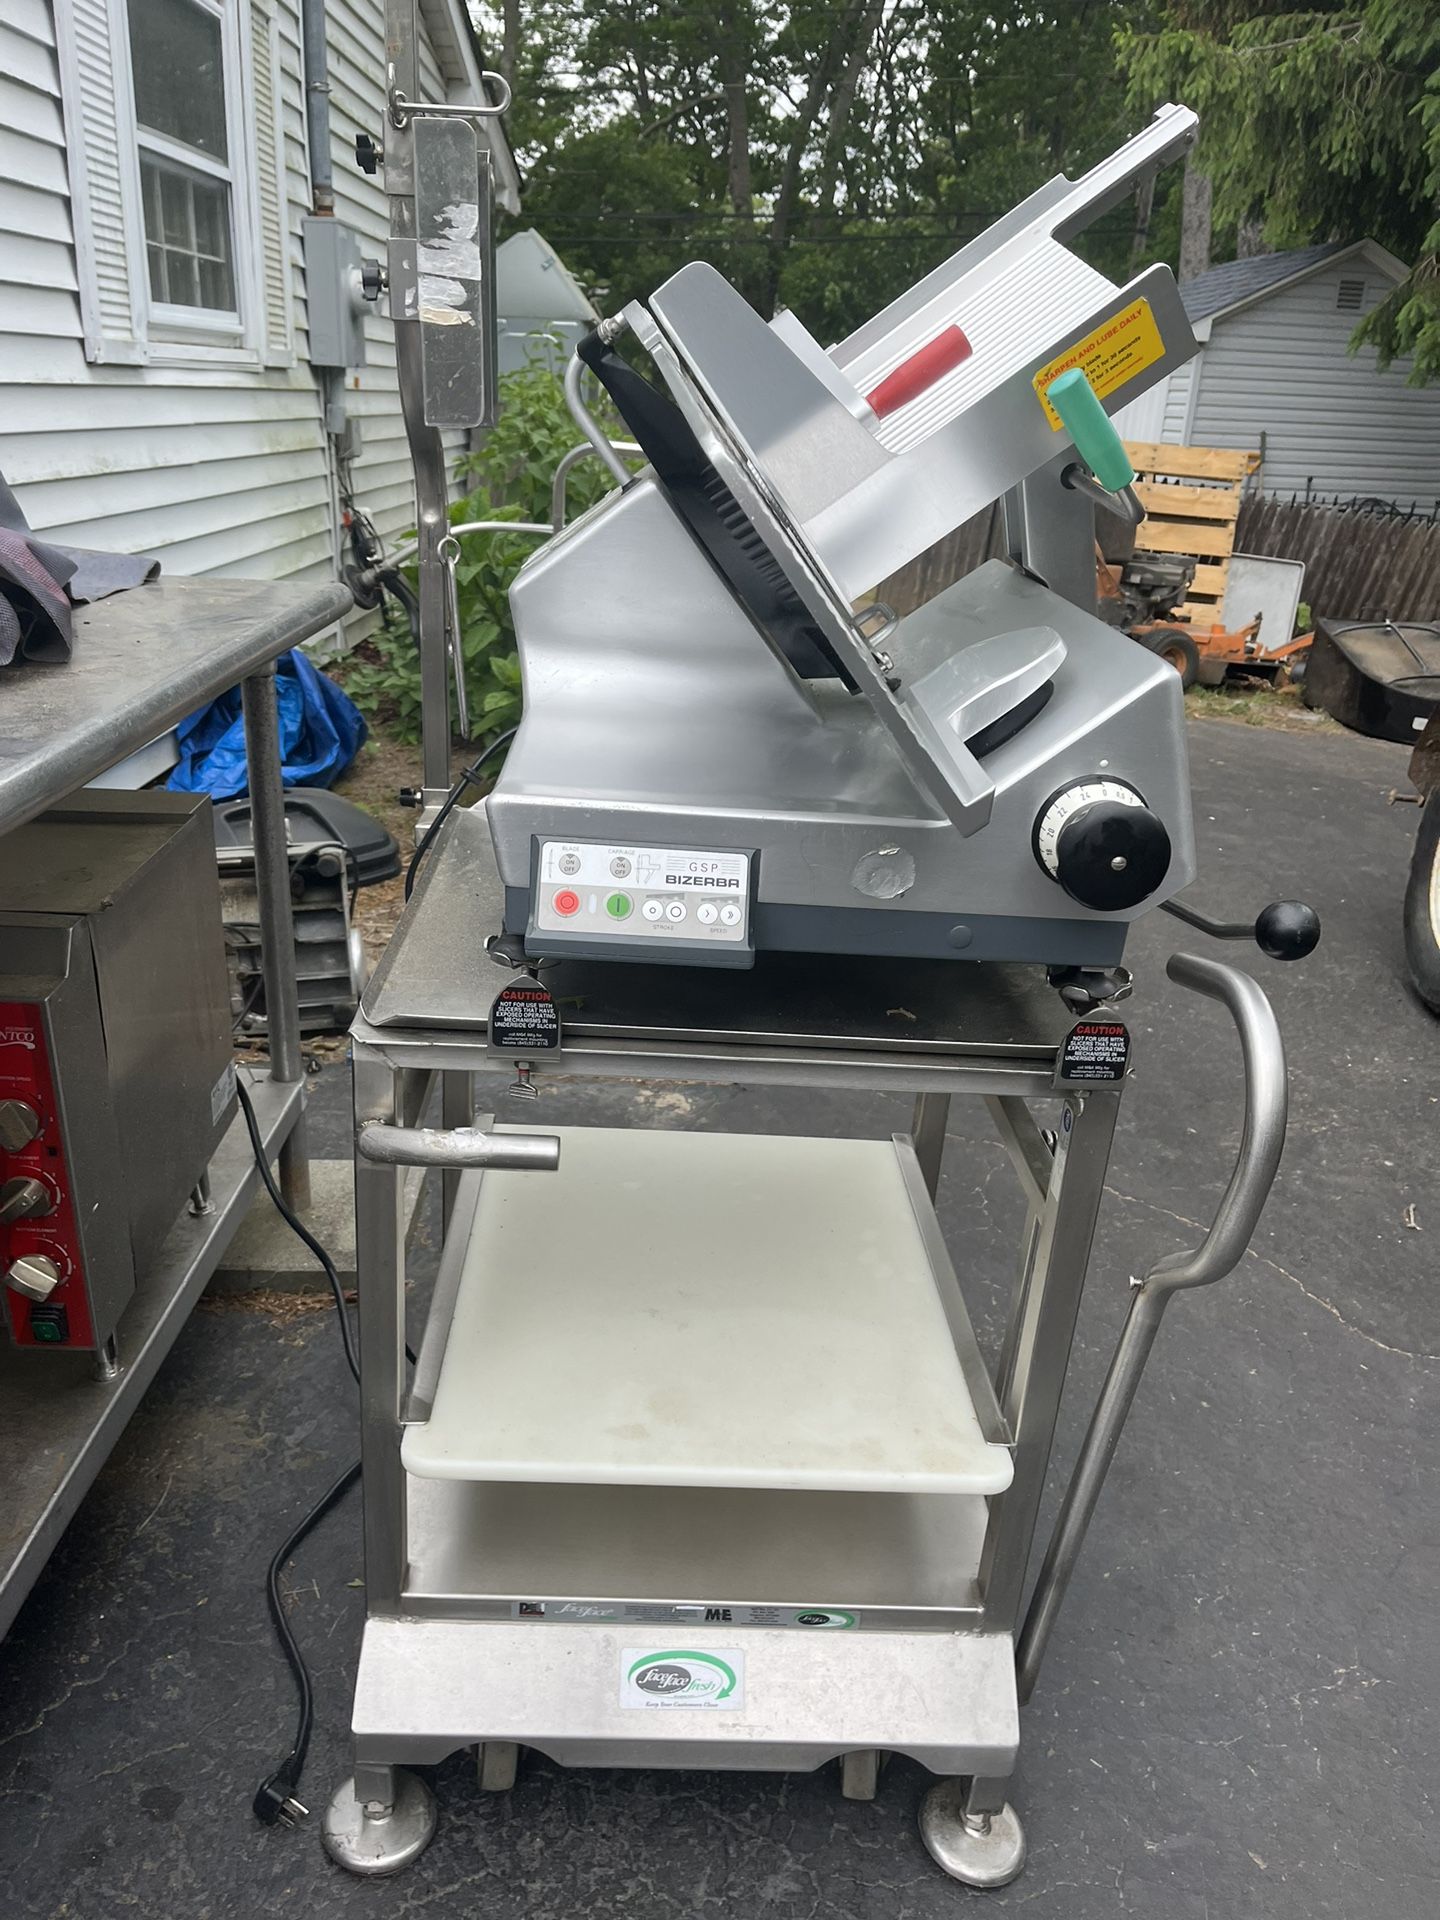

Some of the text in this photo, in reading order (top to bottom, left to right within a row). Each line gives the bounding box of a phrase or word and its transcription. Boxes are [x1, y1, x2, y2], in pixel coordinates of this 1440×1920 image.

[1078, 343, 1096, 360] AND
[1096, 326, 1119, 346] LUBE
[1120, 308, 1142, 328] DAILY
[1047, 827, 1055, 838] 20
[1057, 807, 1068, 818] 22
[1080, 792, 1091, 801] 24
[665, 875, 740, 888] BIZERBA
[502, 990, 551, 1000] CAUTION
[1077, 1026, 1124, 1034] CAUTION
[705, 1608, 732, 1621] ME
[682, 1678, 716, 1692] fresh
